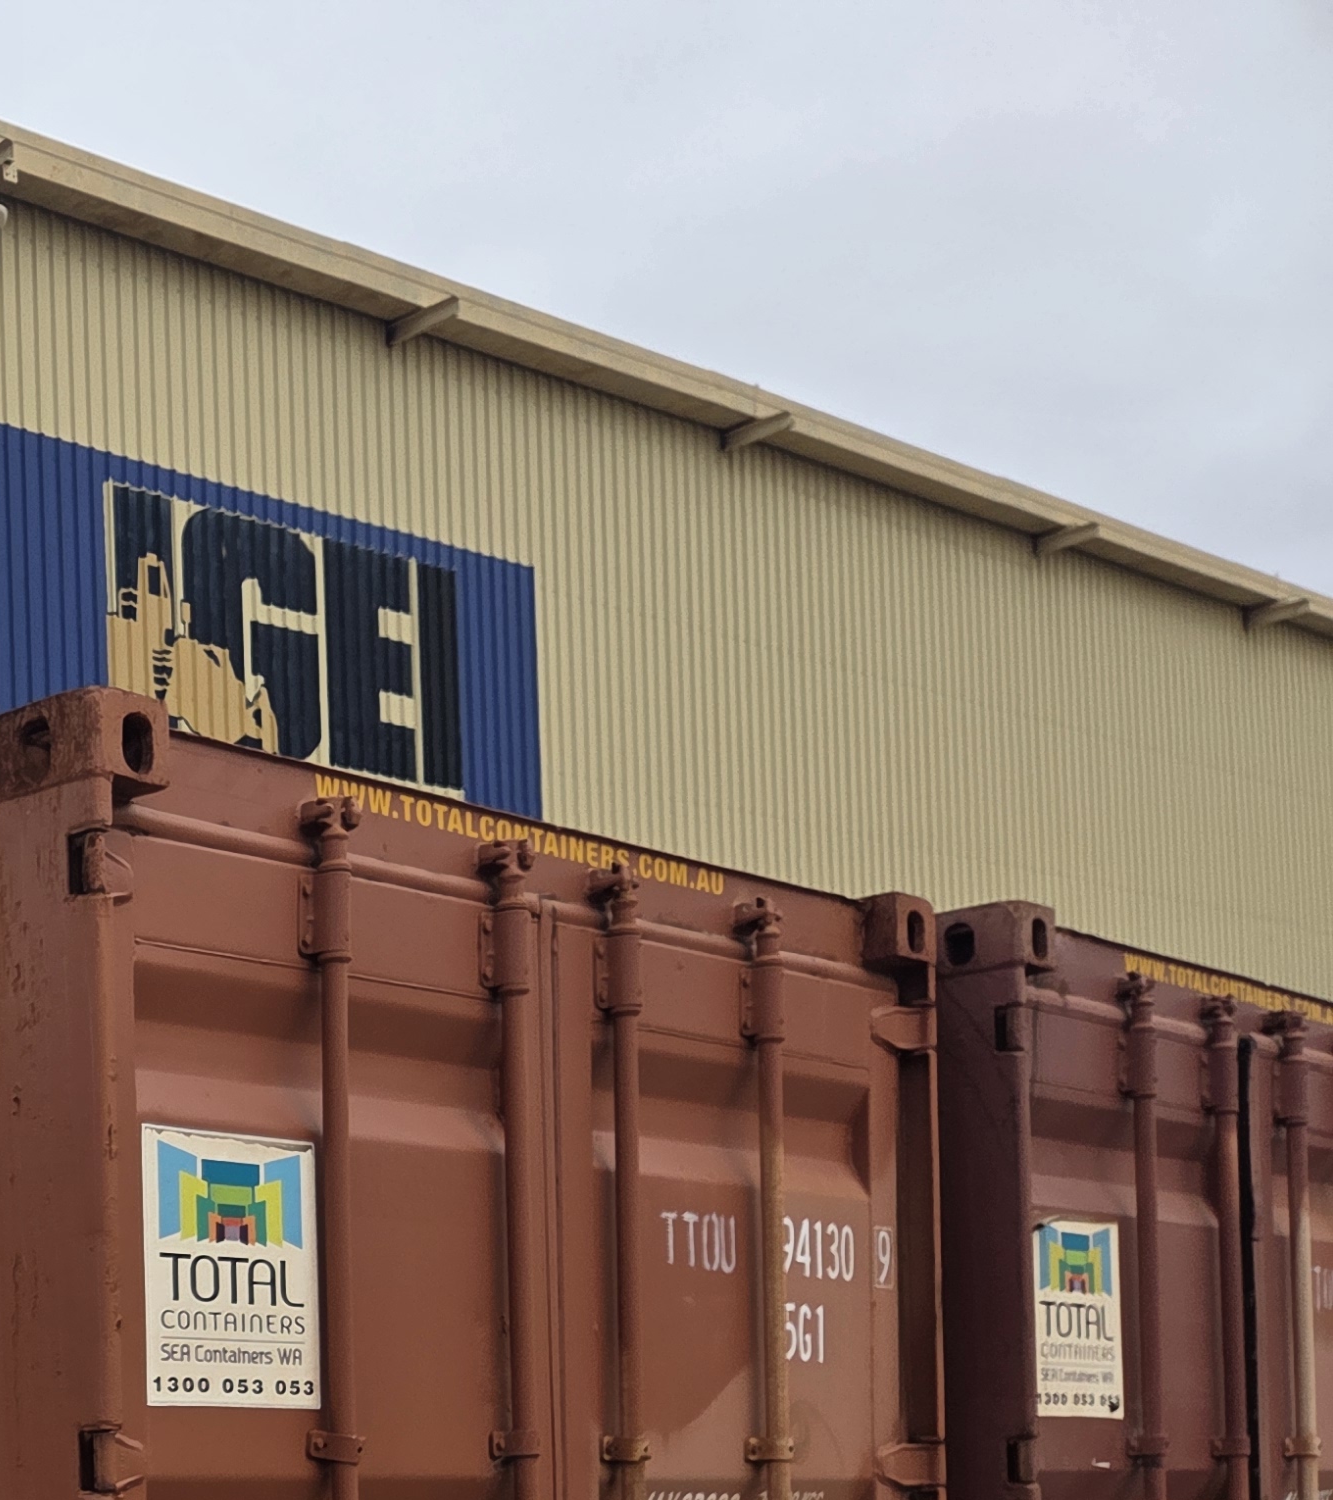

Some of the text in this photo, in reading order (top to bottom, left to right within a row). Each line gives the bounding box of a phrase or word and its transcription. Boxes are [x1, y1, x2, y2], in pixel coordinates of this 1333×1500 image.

[660, 1211, 893, 1285] TTOU 94130 9
[159, 1251, 305, 1308] TOTAL
[160, 1309, 306, 1335] CONTAINERS
[784, 1302, 824, 1364] 5G1
[1039, 1300, 1114, 1341] TOTAL
[160, 1344, 302, 1366] SEA Containers WA
[153, 1376, 315, 1396] 1300 053 053
